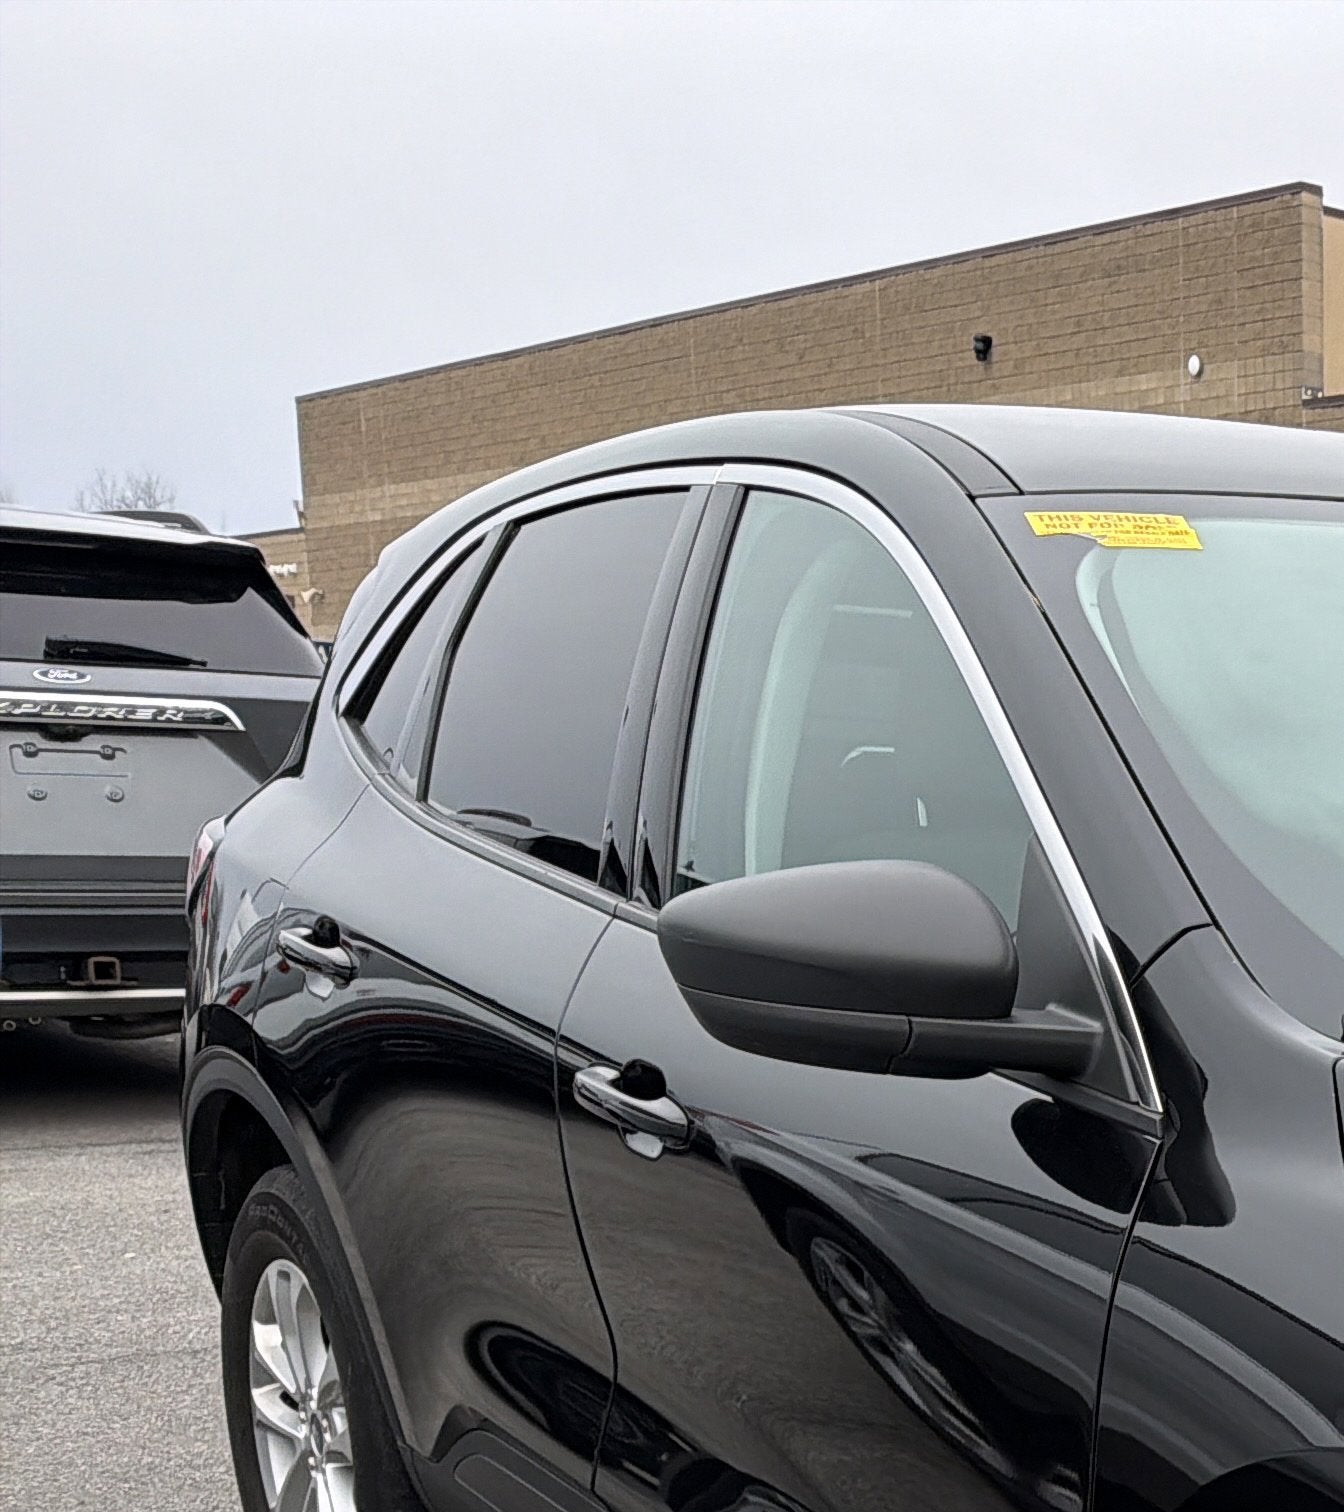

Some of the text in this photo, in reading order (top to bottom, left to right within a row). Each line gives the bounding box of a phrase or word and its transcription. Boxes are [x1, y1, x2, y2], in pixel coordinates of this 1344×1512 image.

[1035, 513, 1179, 526] THIS VEHICLE
[1044, 522, 1080, 530] NOT
[48, 668, 79, 680] Ford
